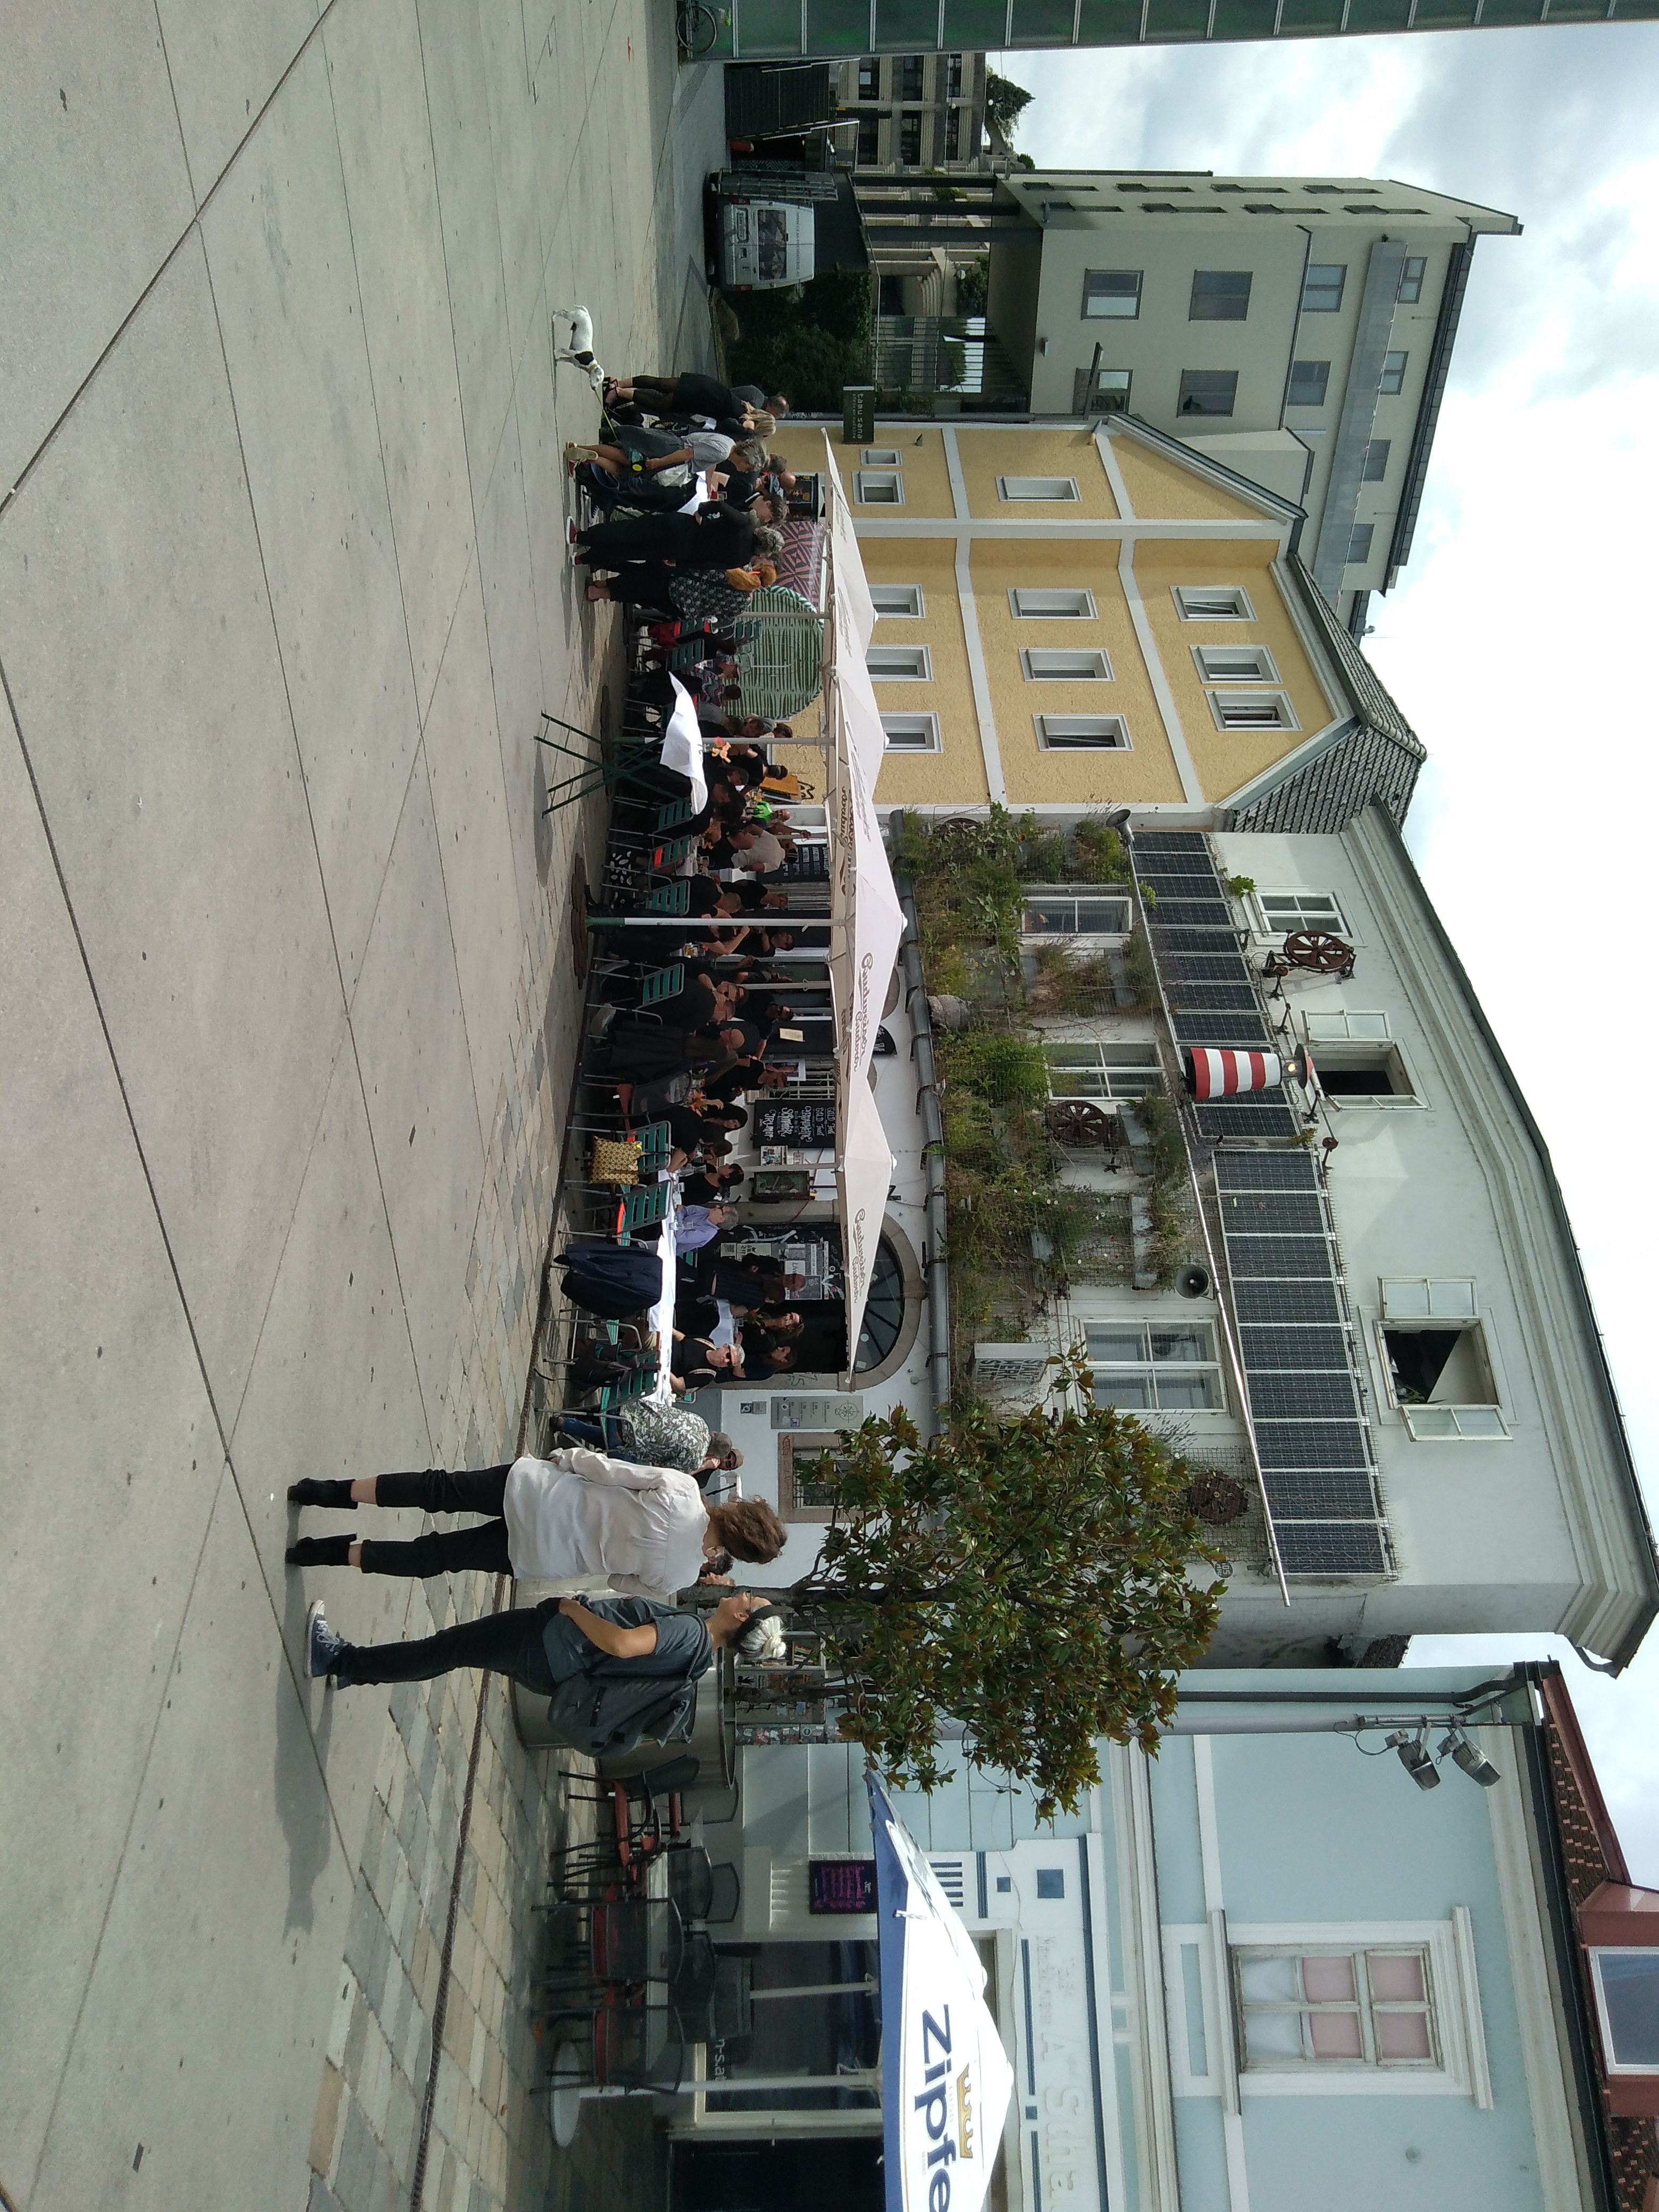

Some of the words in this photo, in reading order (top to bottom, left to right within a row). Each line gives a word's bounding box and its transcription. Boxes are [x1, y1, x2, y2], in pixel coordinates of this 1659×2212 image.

[860, 952, 874, 1059] Budweiser
[854, 1011, 863, 1071] Budvar
[854, 1208, 866, 1289] Budweiser
[996, 1360, 1024, 1380] WERK
